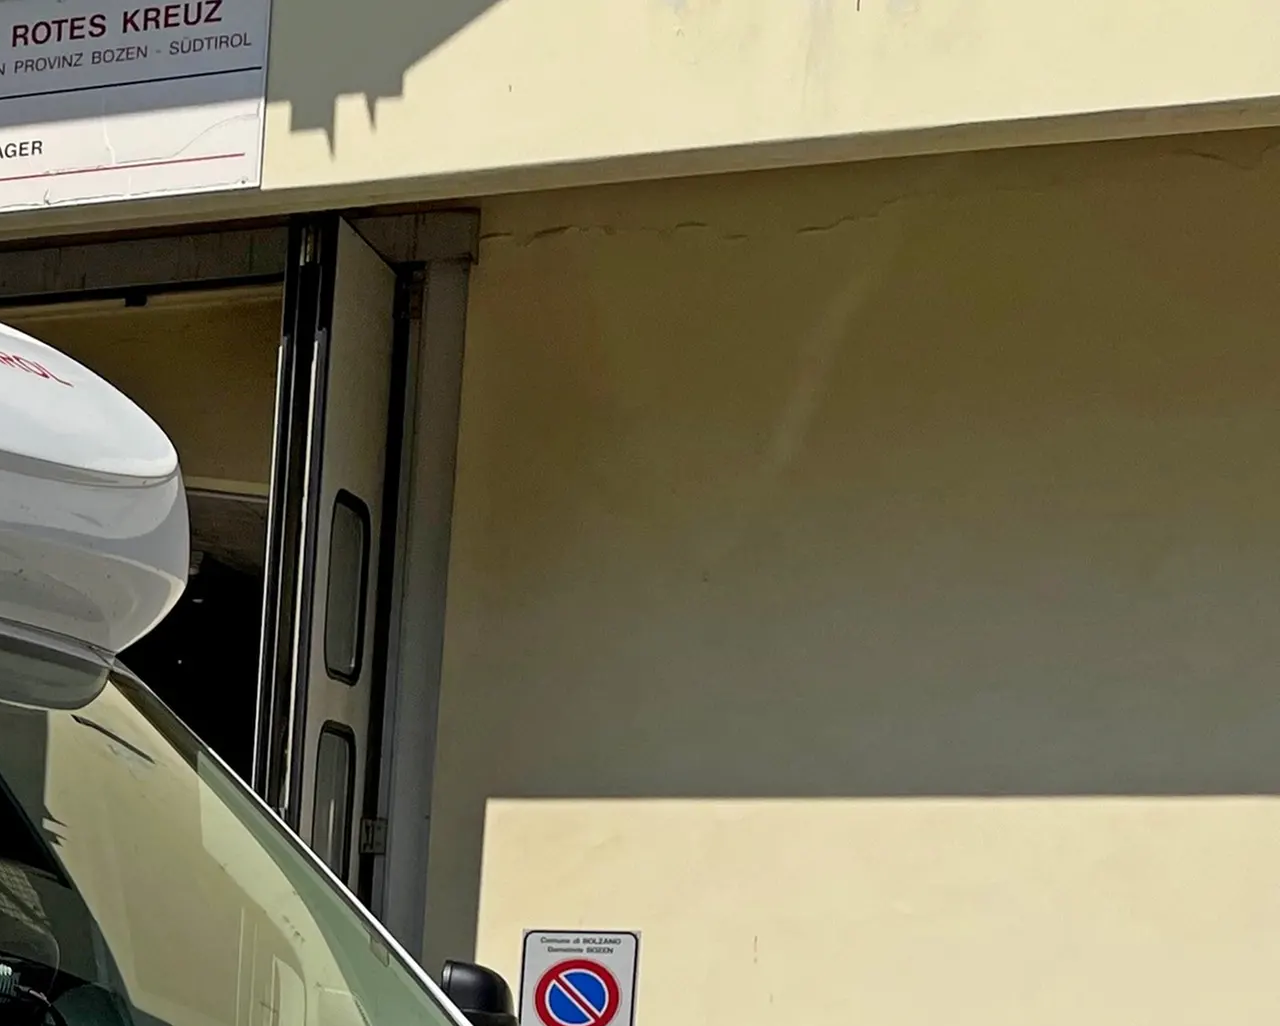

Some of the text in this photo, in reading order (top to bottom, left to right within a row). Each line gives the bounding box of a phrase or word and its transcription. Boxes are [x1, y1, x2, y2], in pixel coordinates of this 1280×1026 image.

[12, 14, 107, 47] ROTES
[122, 0, 223, 34] KREUZ
[14, 52, 83, 74] PROVINZ
[91, 45, 148, 65] BOZEN
[168, 31, 252, 56] SÜDTIROL
